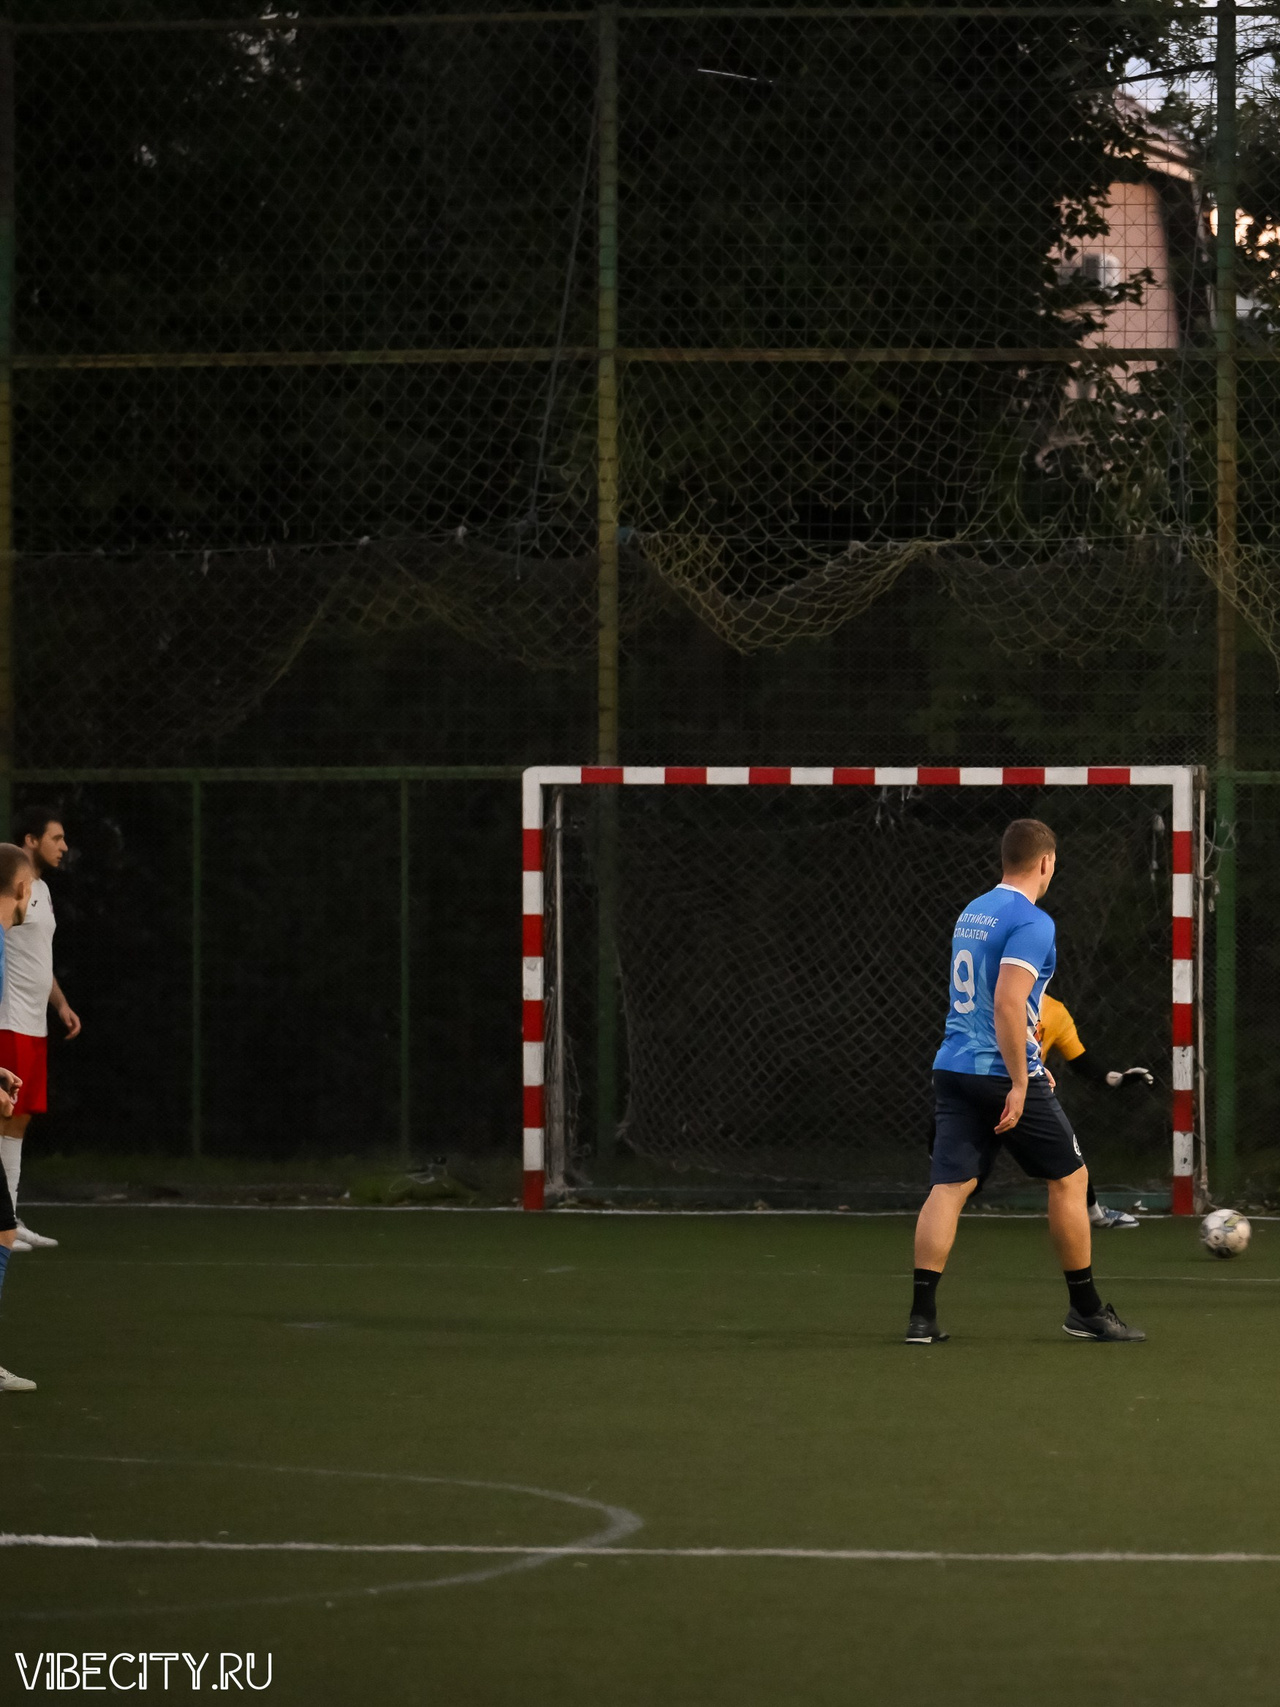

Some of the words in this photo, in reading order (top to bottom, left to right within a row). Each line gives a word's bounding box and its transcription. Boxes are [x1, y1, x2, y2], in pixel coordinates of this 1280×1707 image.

[956, 912, 1000, 928] АЛТИЙСКИЕ
[953, 927, 990, 942] СПАСАТЕЛИ
[953, 949, 976, 1014] 9
